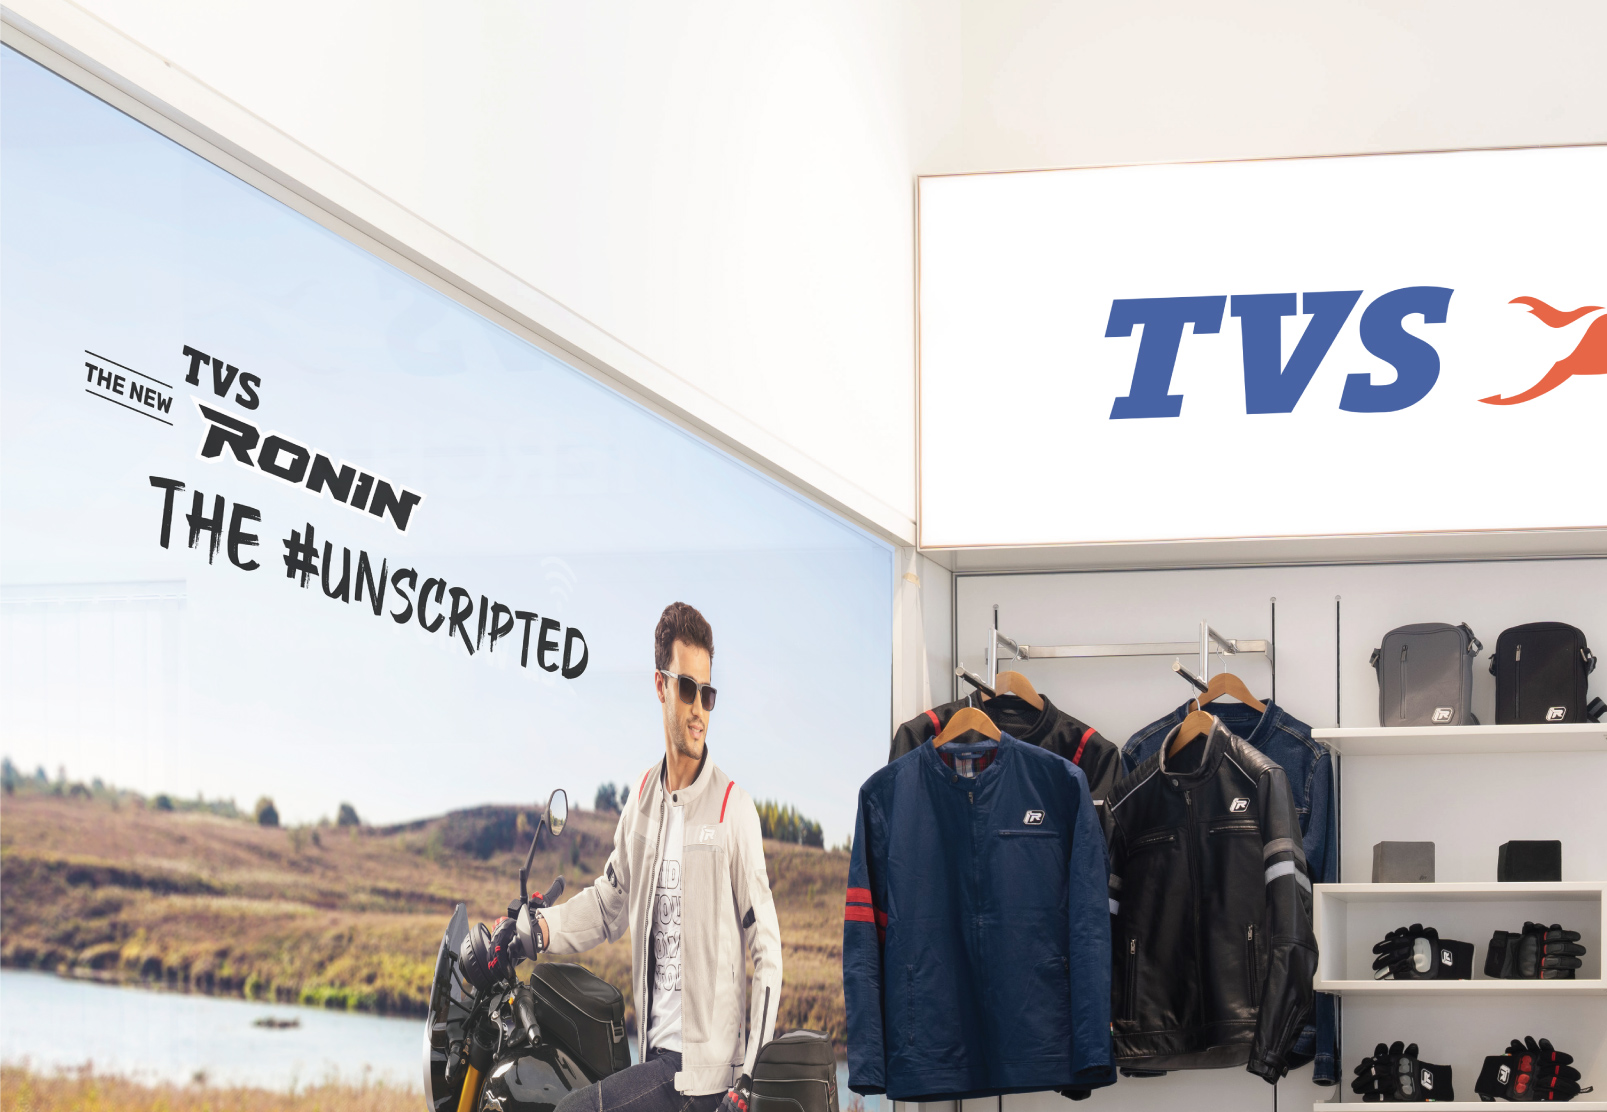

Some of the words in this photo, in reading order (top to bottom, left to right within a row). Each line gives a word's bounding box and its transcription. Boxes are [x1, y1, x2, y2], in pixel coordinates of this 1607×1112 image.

[84, 361, 126, 396] THE
[129, 381, 173, 414] NEW
[182, 344, 262, 411] TVS
[1104, 285, 1455, 420] TVS
[198, 403, 422, 532] RONIN
[148, 475, 262, 573] THE
[282, 522, 589, 680] #UNSCRIPTED
